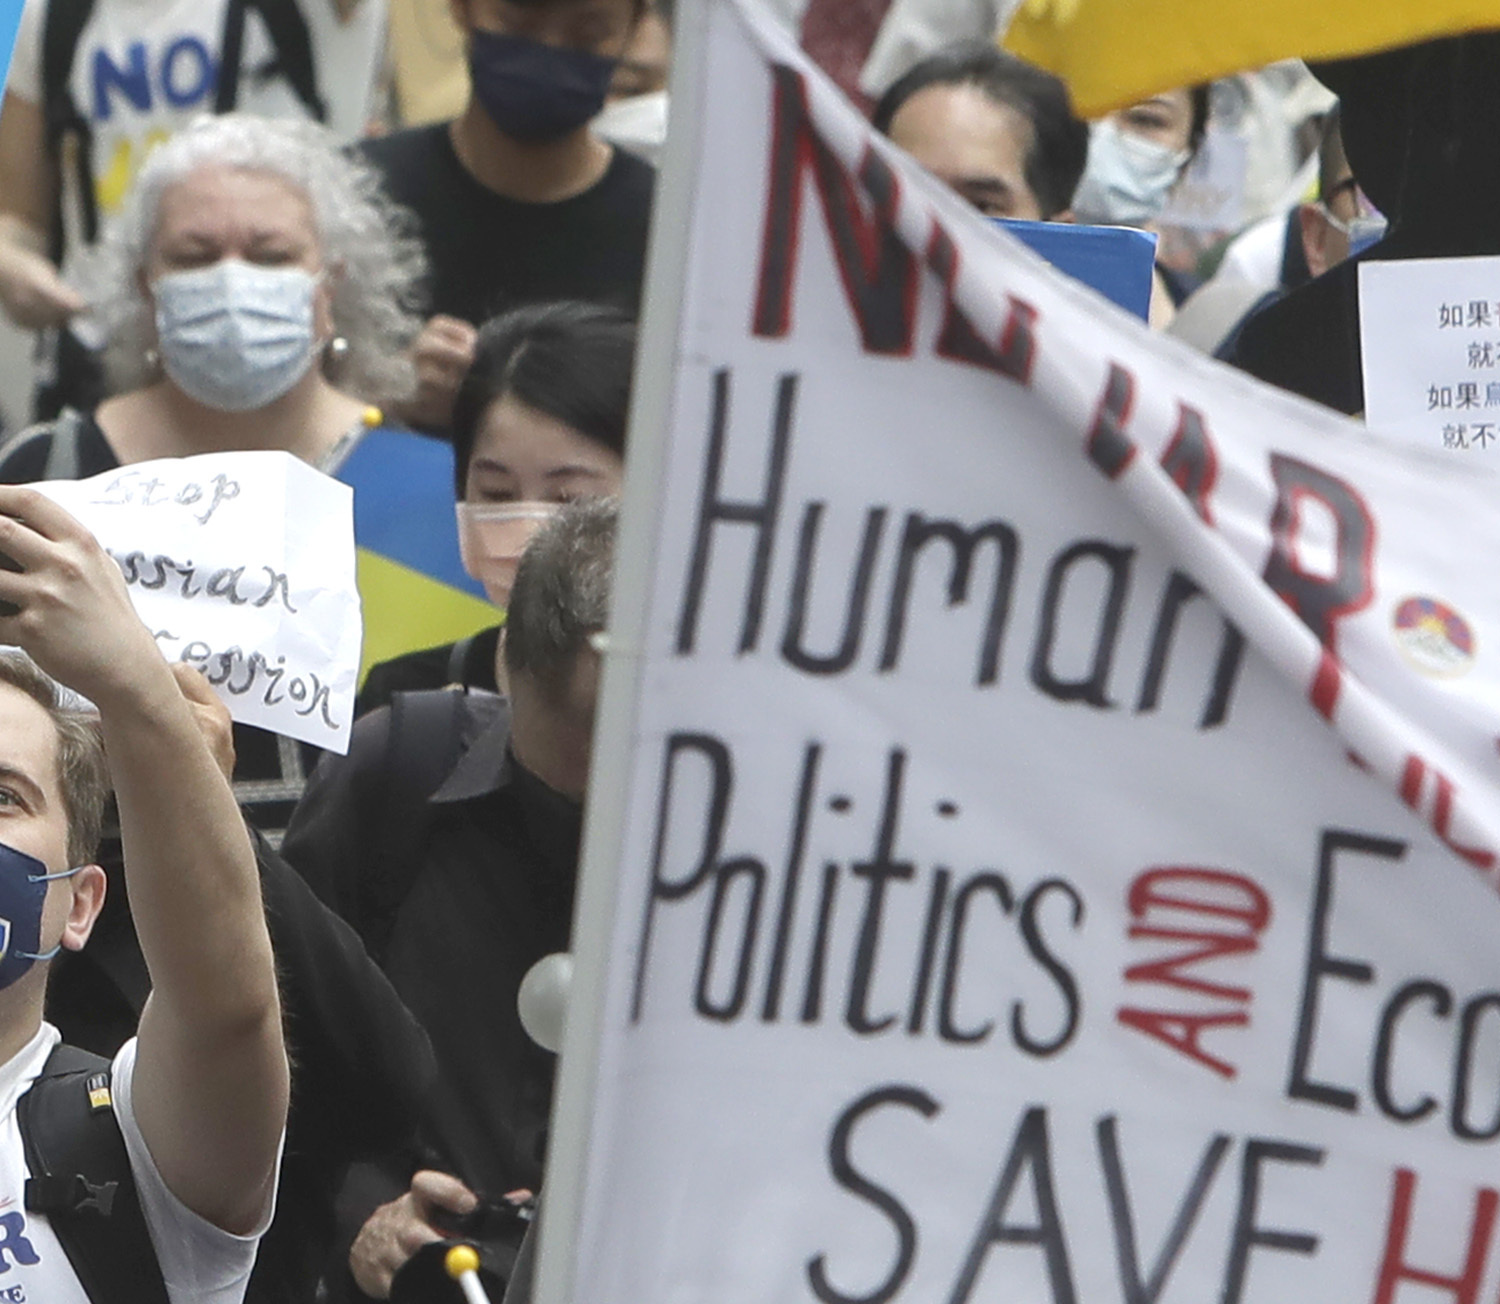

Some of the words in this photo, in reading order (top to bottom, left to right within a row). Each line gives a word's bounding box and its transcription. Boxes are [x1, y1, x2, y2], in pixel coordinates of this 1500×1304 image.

[90, 36, 218, 120] NO
[672, 366, 1252, 729] Human
[628, 732, 1085, 1060] Politics
[1115, 863, 1275, 1080] AND
